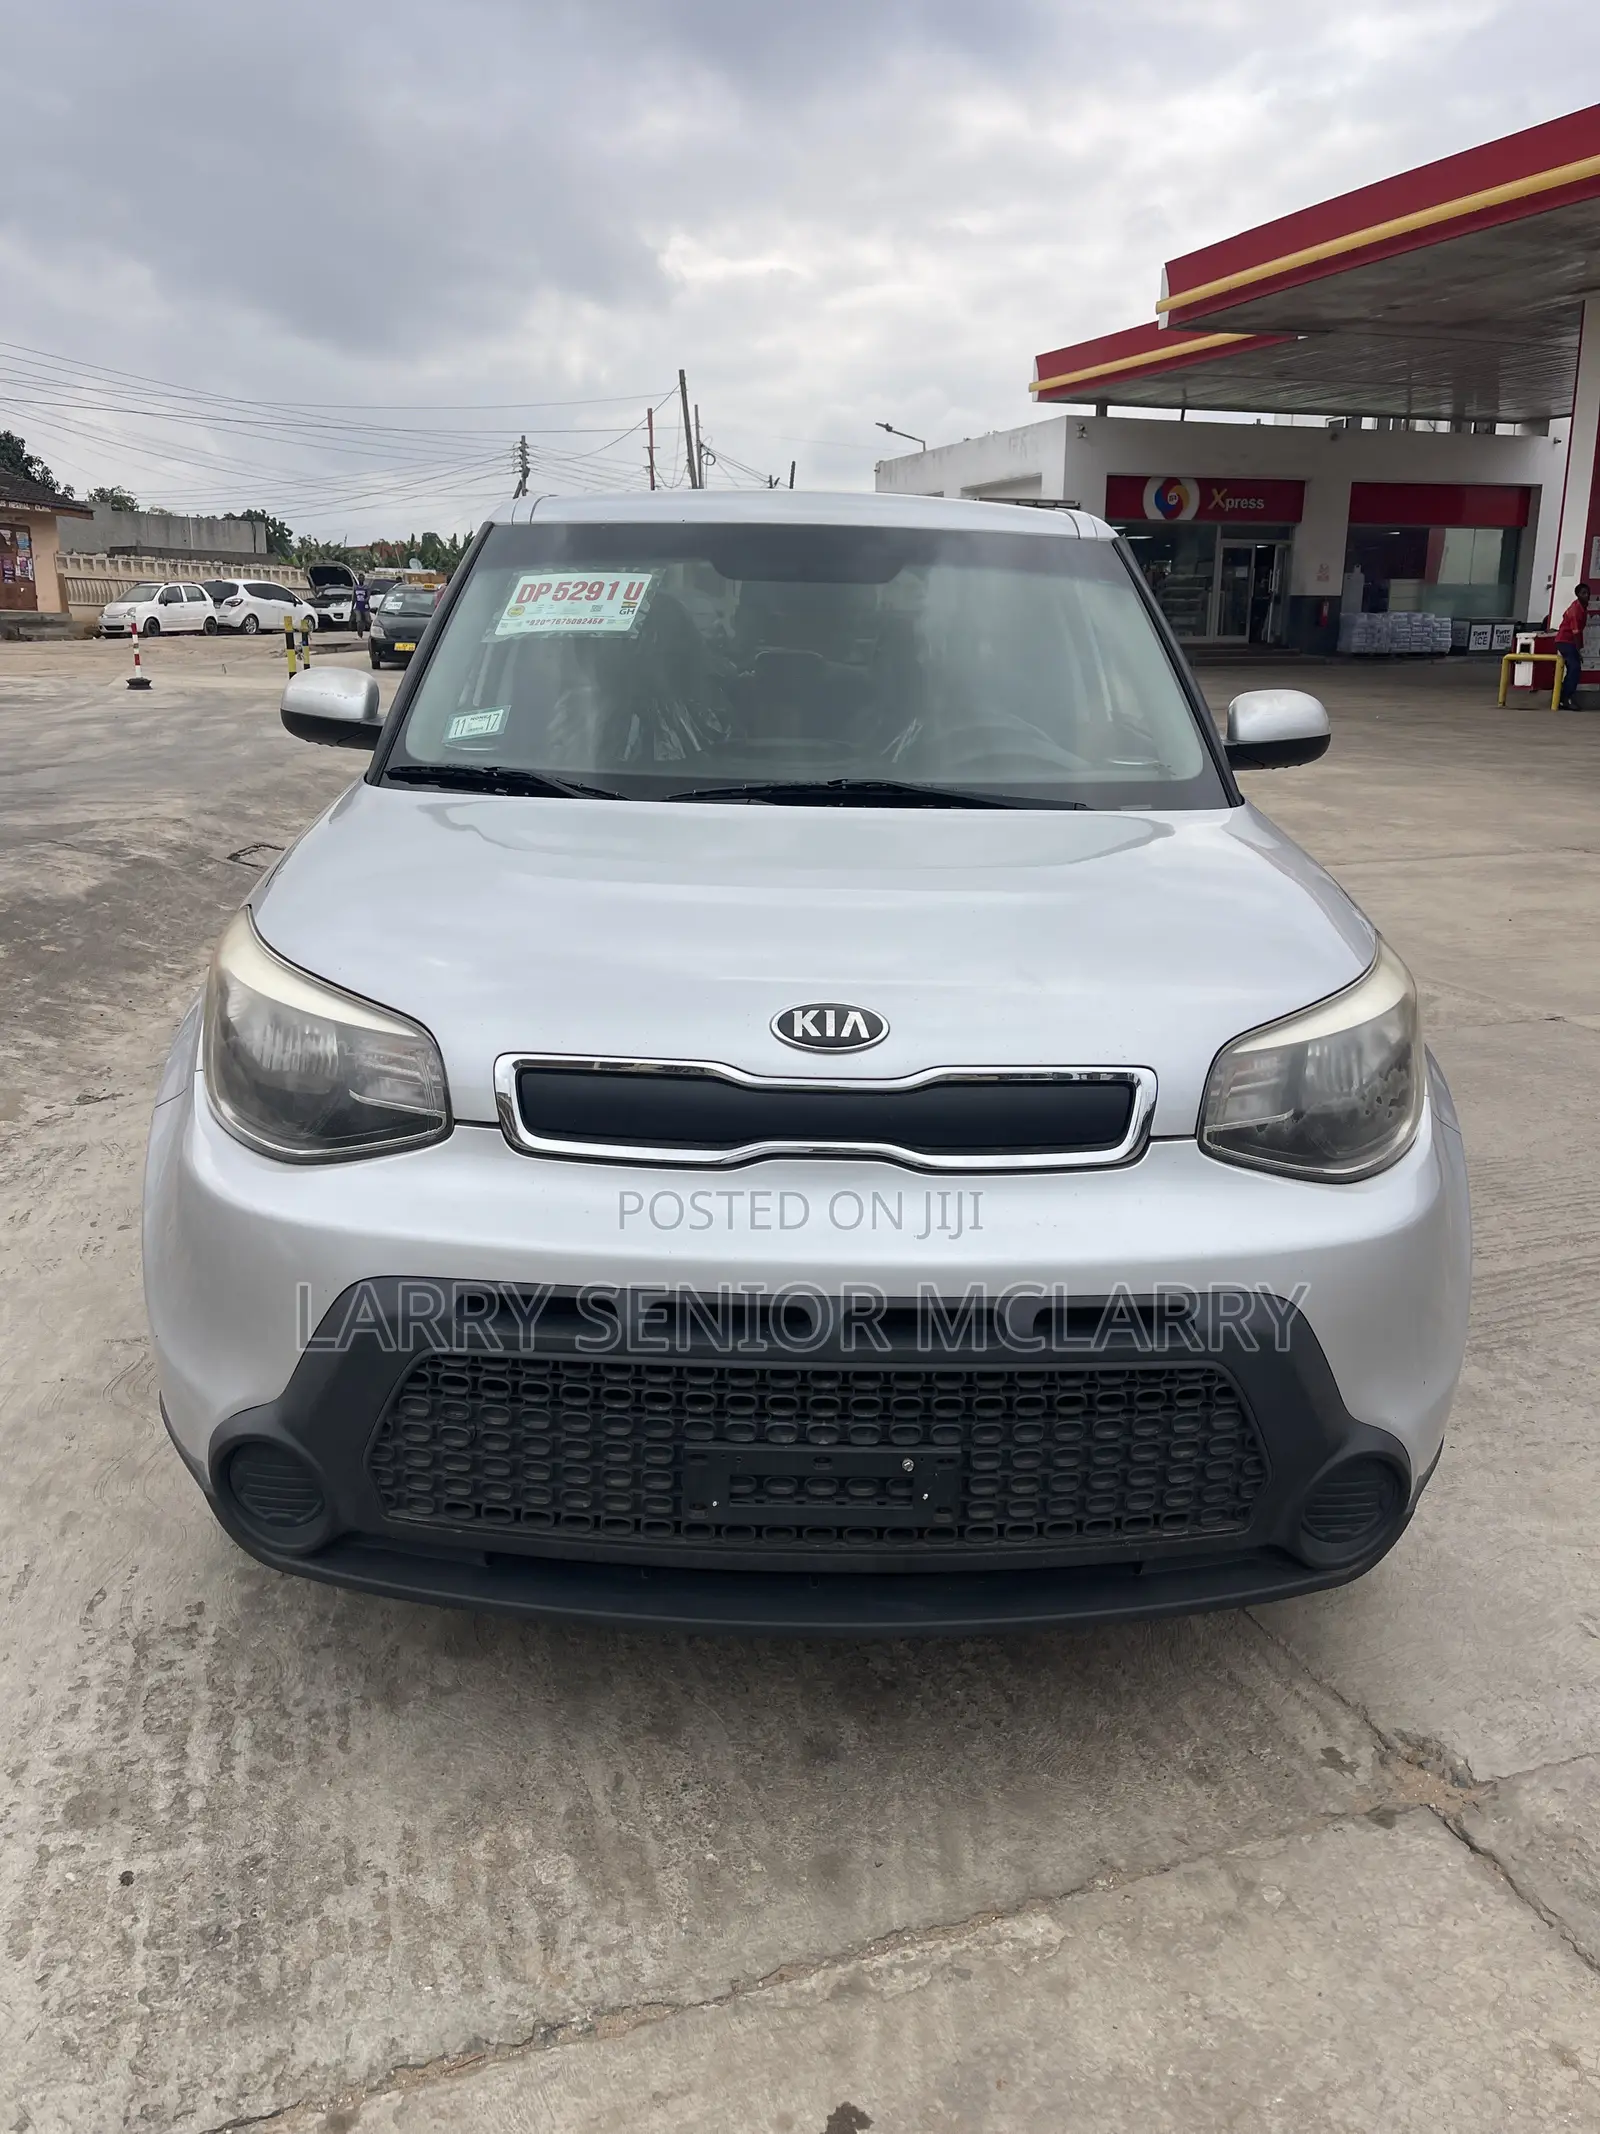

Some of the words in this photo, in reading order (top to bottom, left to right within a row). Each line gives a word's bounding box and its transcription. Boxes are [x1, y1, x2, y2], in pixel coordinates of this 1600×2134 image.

[1207, 488, 1265, 512] Xpress
[514, 582, 553, 604] DP
[551, 581, 621, 602] 5291
[623, 581, 645, 602] U
[619, 608, 636, 616] GH
[485, 713, 501, 731] 17
[792, 1009, 870, 1039] KIA
